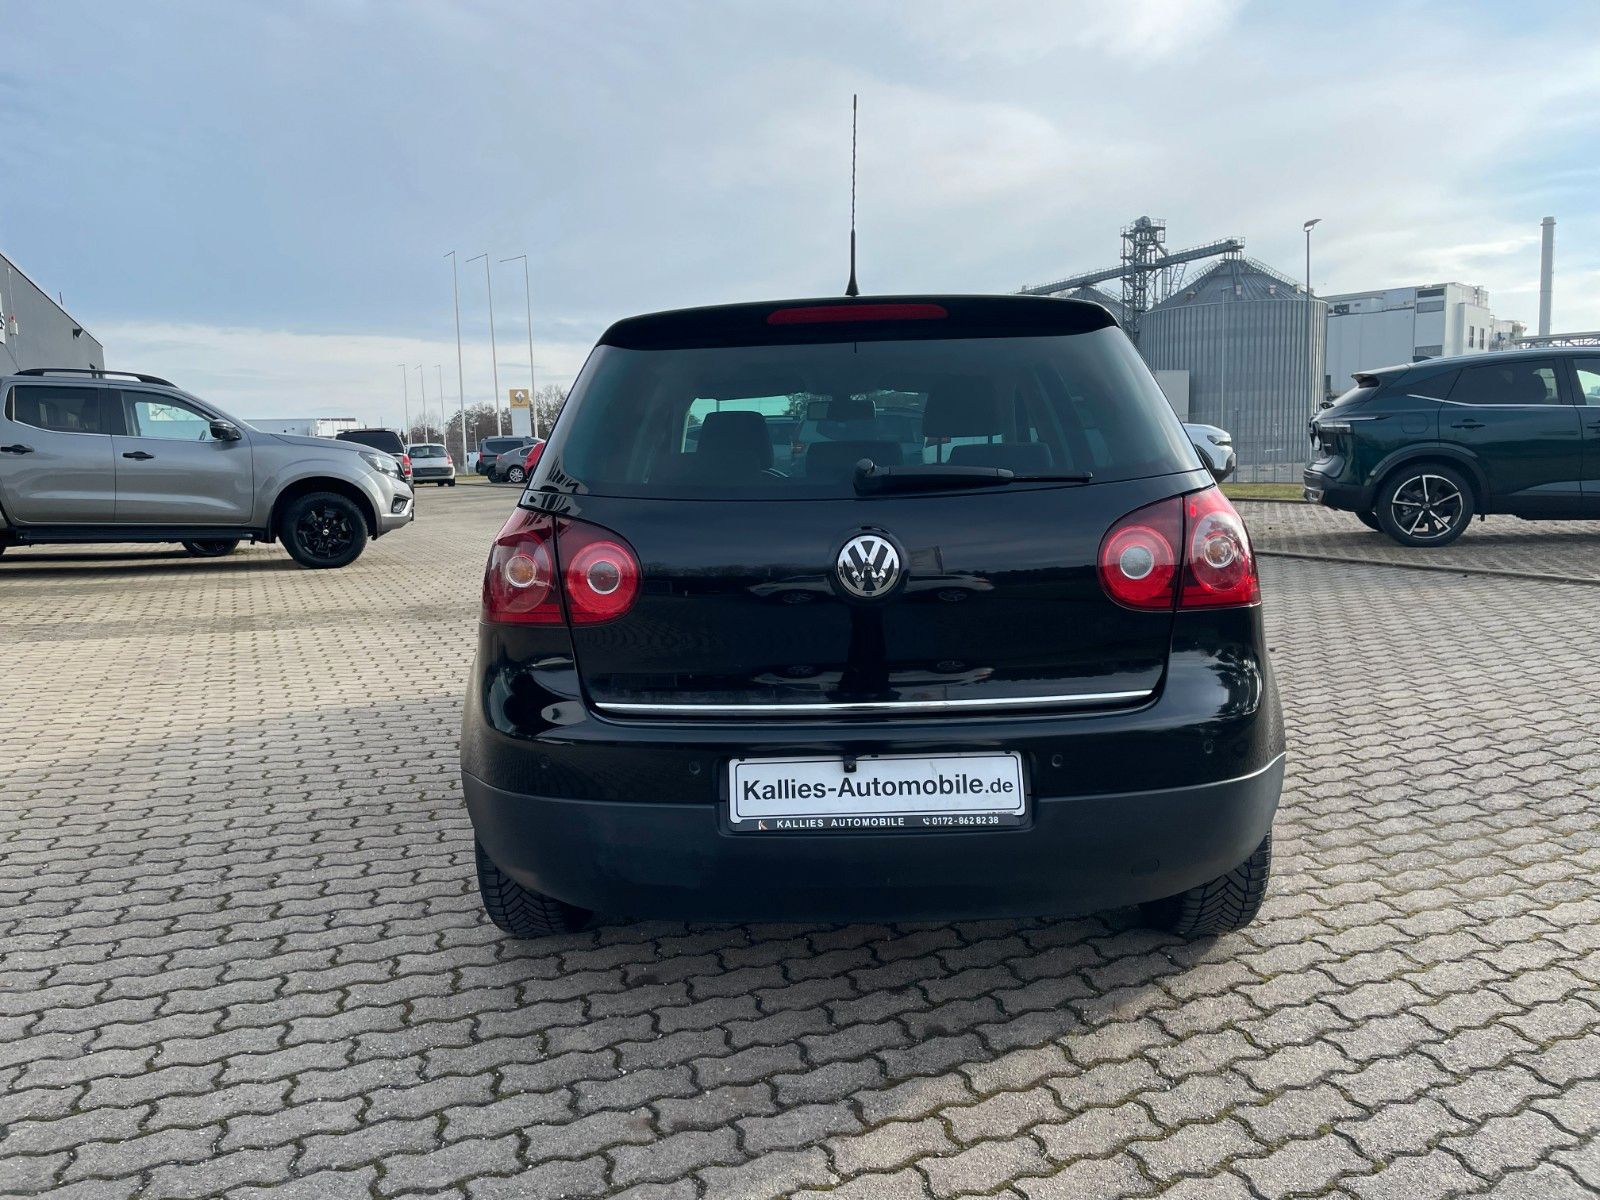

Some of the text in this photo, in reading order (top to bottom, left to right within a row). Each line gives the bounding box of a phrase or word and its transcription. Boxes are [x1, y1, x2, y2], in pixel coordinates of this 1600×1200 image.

[743, 773, 1014, 800] Kallies-Automobile.de
[776, 817, 905, 828] KALLIES AUTOMOBILE
